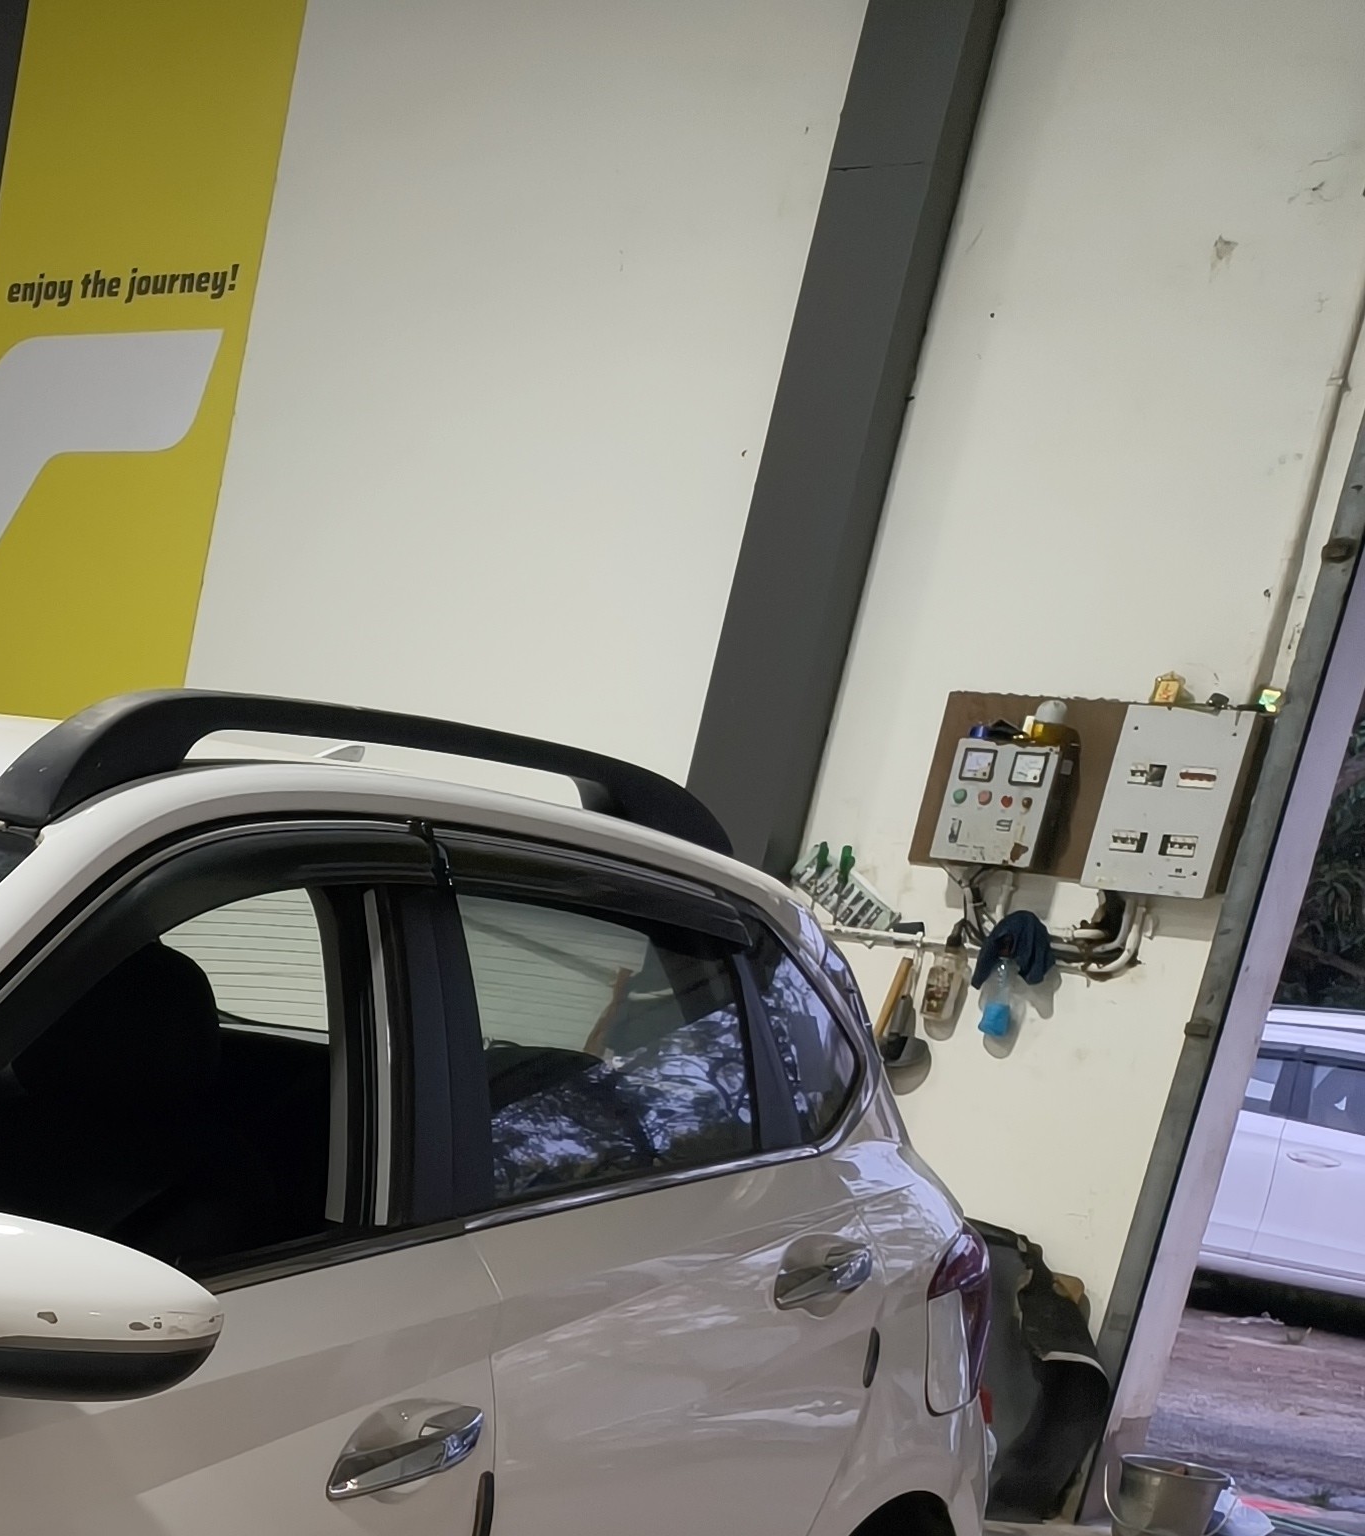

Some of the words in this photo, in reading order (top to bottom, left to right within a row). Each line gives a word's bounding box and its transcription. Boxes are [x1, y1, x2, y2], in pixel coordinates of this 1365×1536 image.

[7, 273, 73, 308] enjoy
[80, 270, 121, 299] the
[124, 264, 239, 304] journey!
